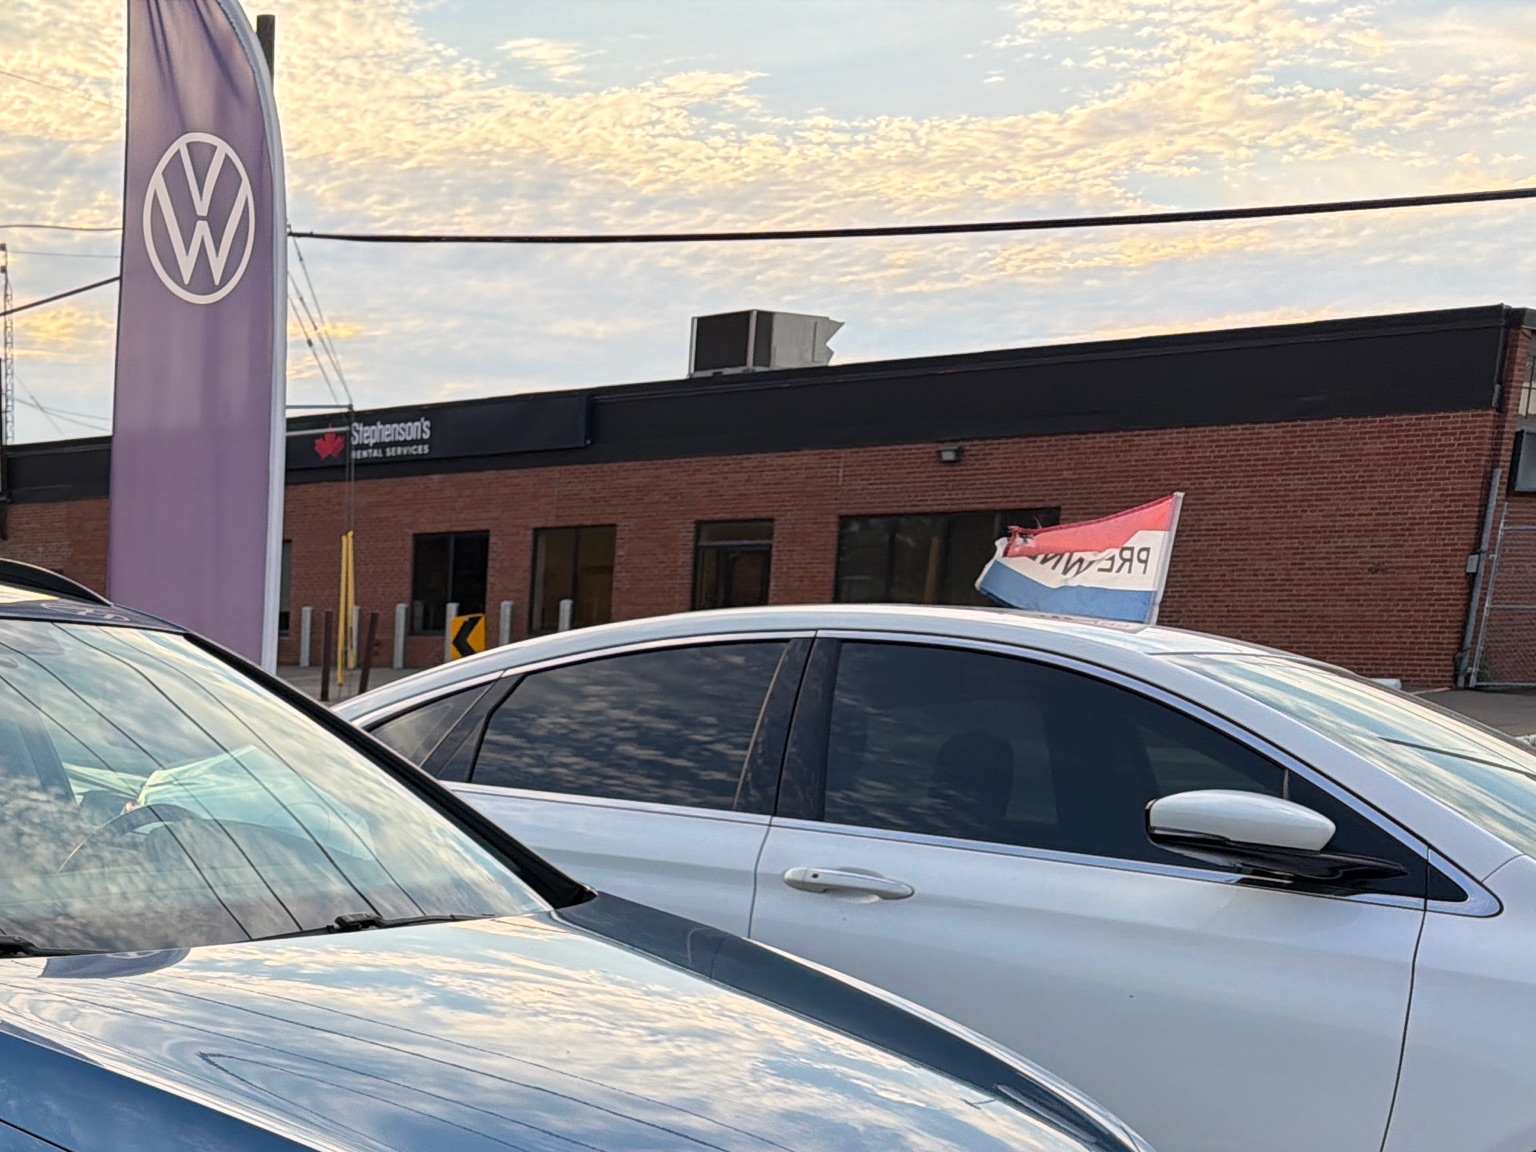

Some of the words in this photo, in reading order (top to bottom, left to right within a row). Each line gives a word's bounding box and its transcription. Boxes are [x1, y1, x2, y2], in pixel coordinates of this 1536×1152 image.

[143, 132, 255, 305] VW
[351, 417, 431, 447] Stephenson's
[351, 448, 383, 459] RENTAL
[385, 444, 430, 457] SERVICES
